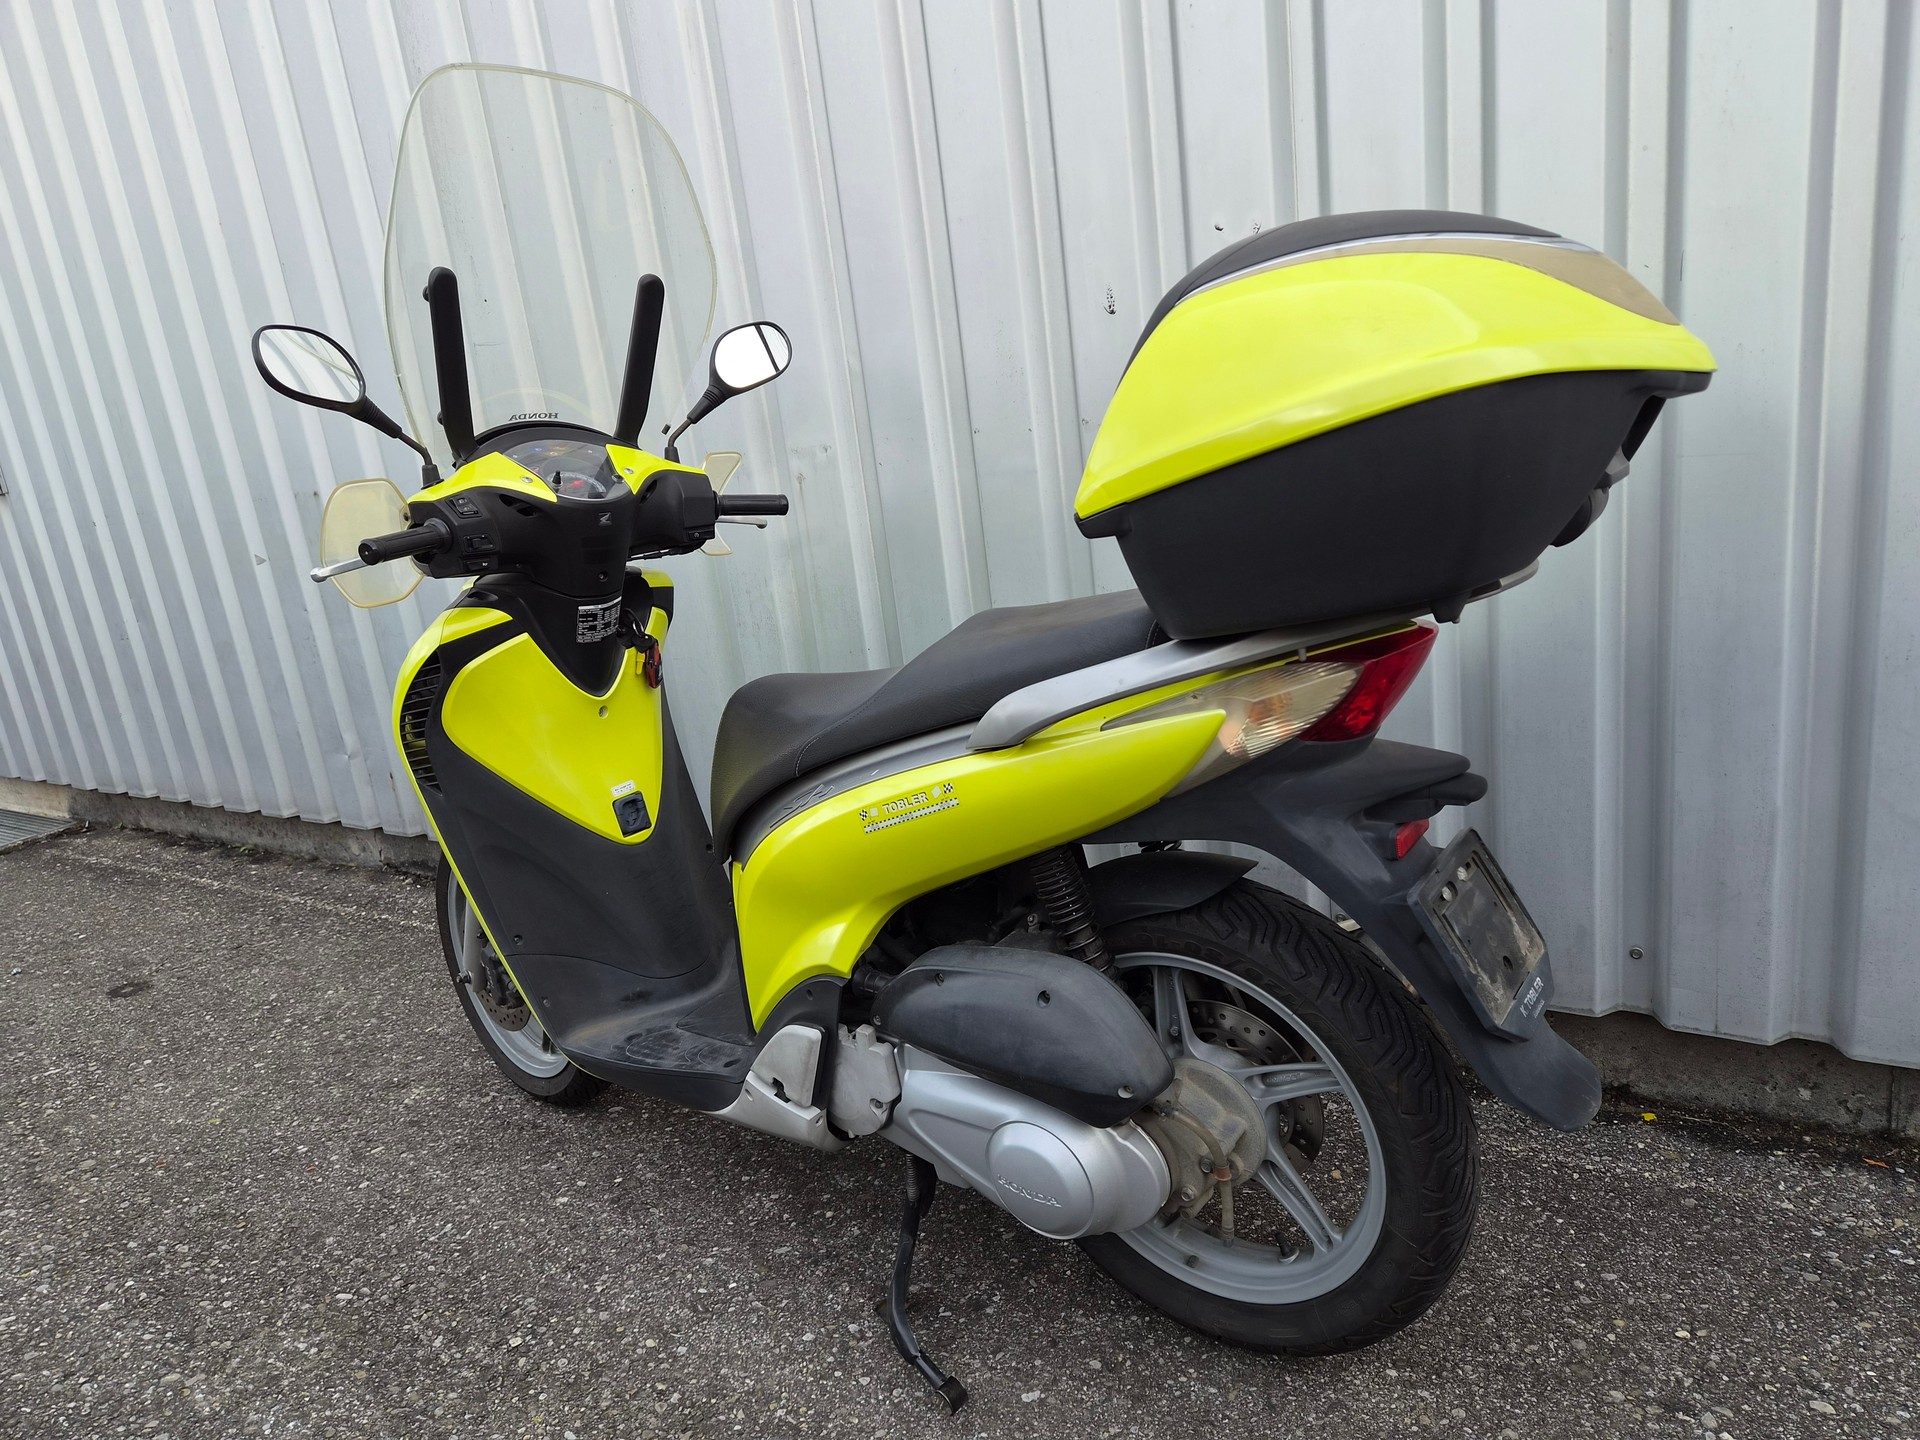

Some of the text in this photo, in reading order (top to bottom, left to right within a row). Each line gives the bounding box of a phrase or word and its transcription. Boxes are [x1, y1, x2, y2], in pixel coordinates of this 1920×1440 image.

[881, 791, 929, 814] TOBLER
[1523, 976, 1544, 1009] TOBLER
[997, 1174, 1062, 1208] HONDA
